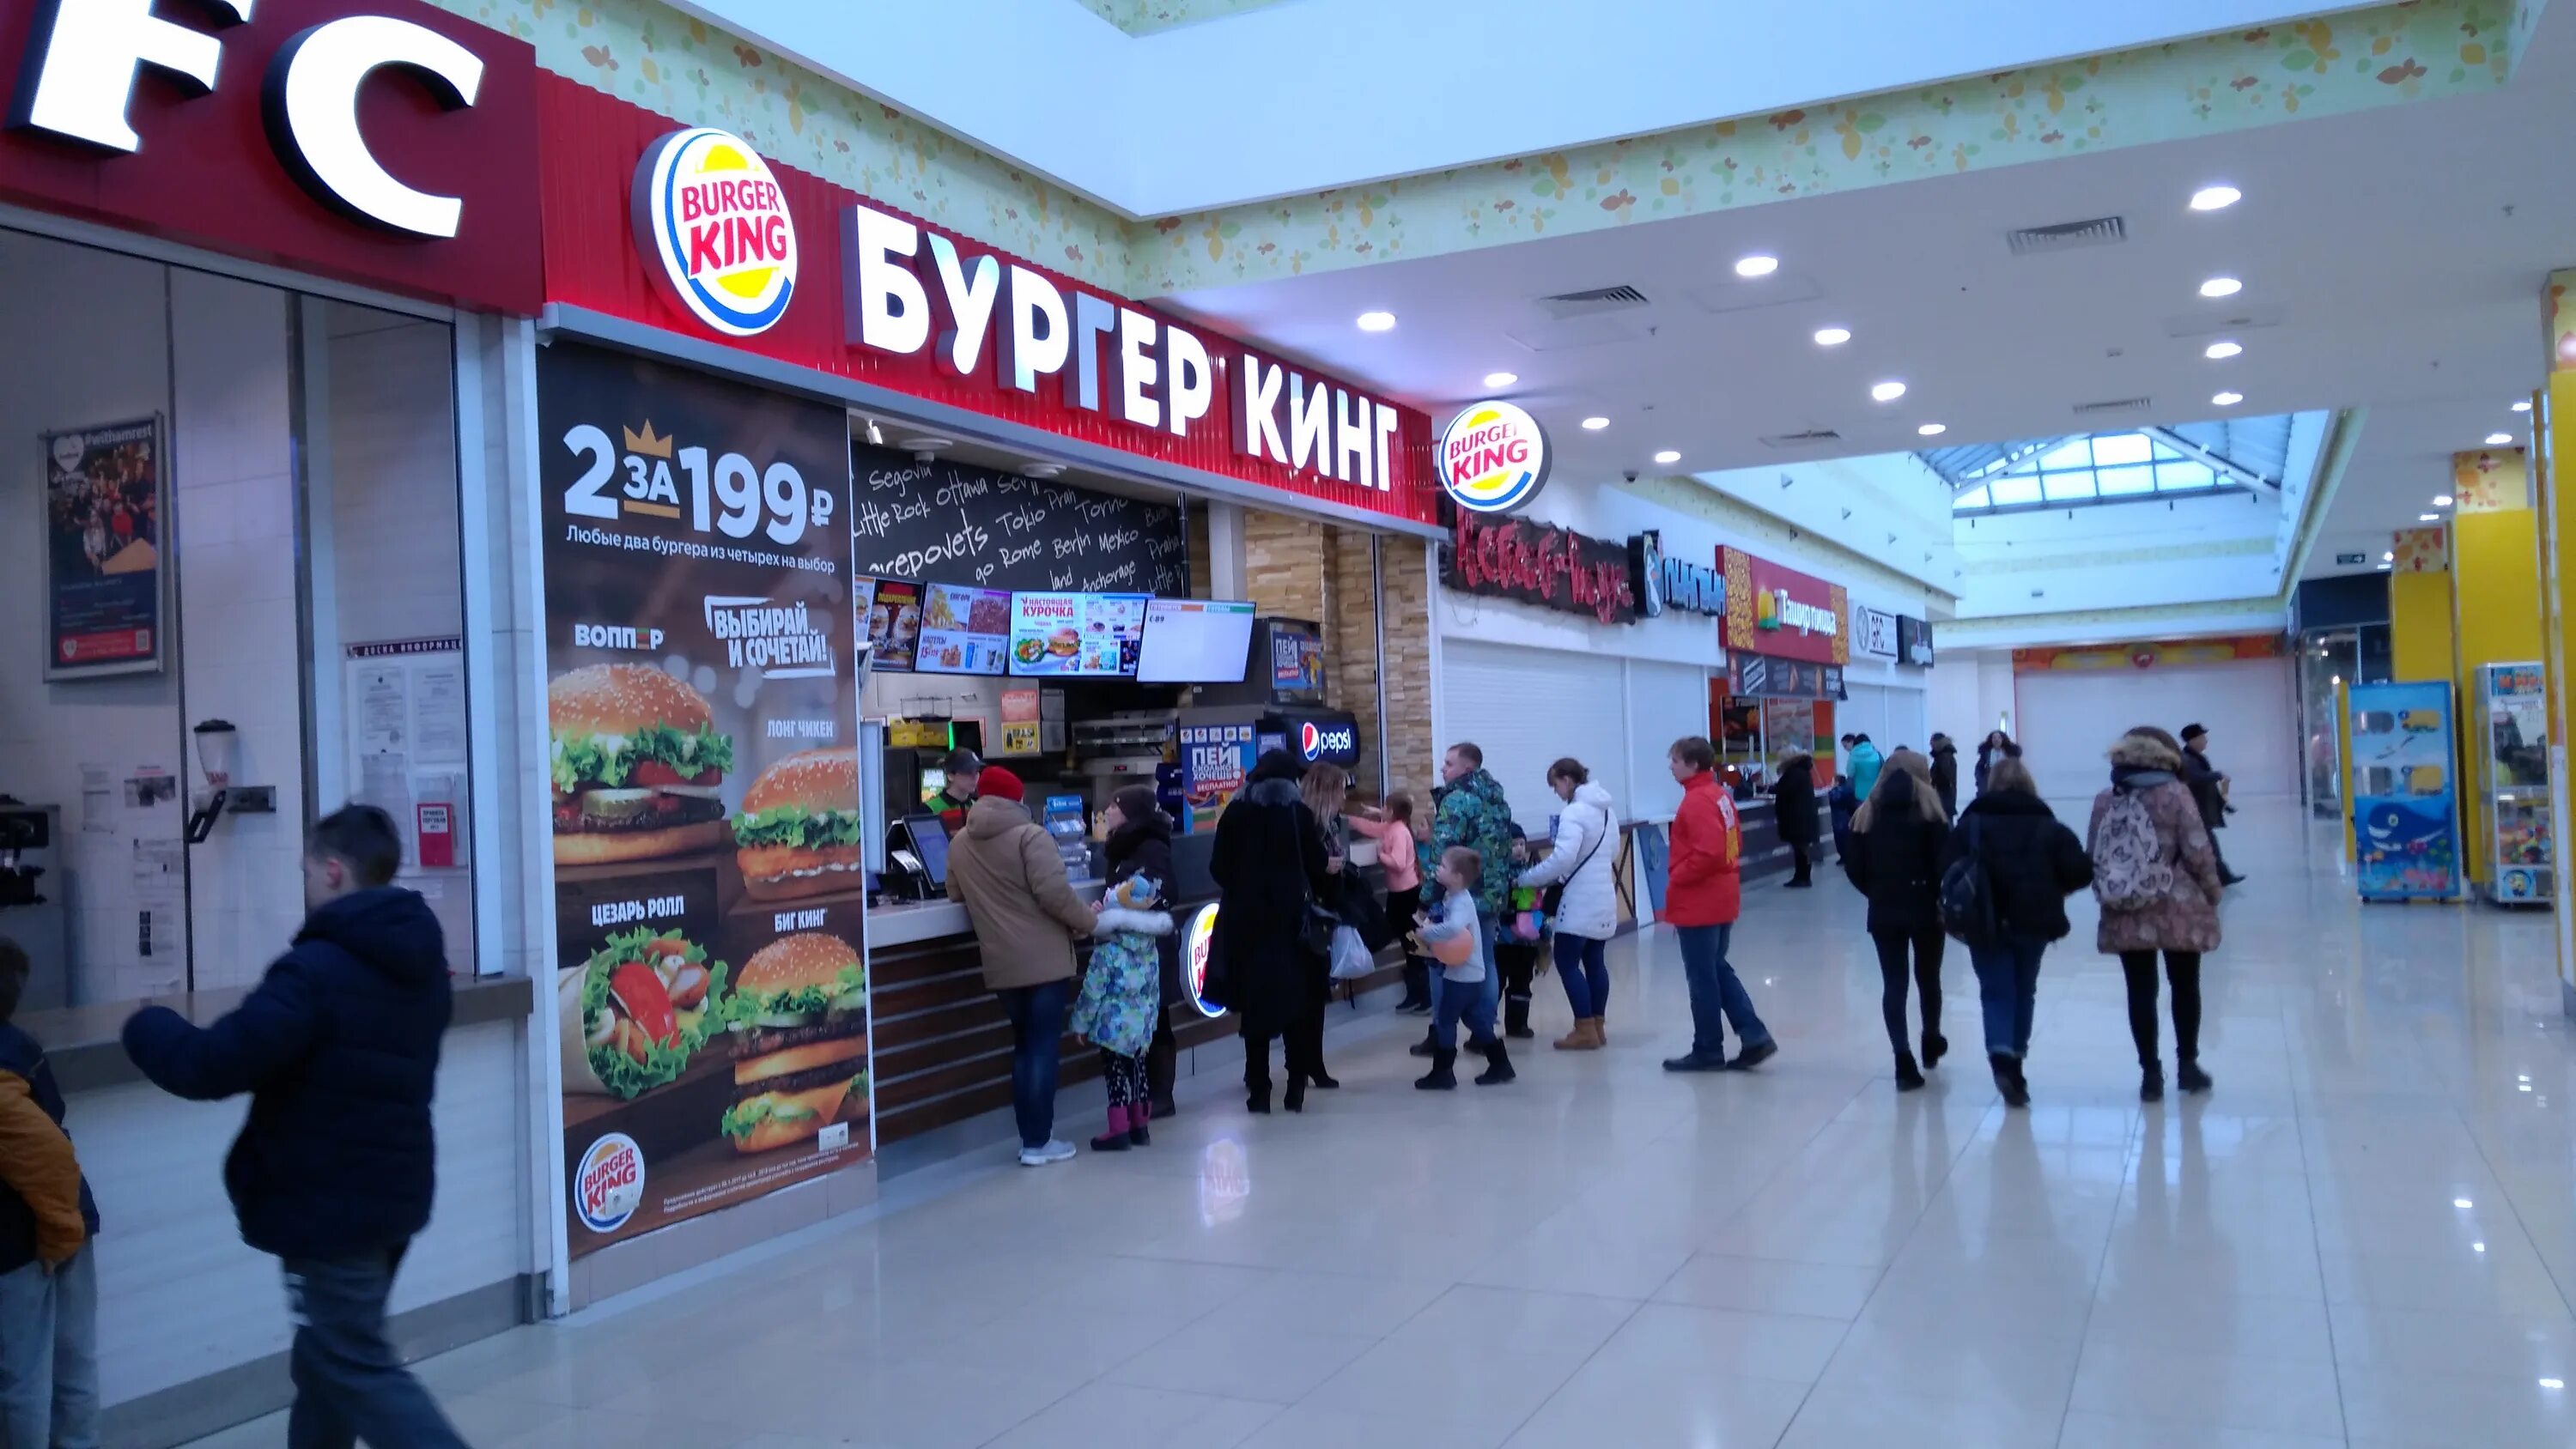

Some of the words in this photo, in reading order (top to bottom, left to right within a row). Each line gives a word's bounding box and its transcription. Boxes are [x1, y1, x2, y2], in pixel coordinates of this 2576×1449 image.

[681, 179, 781, 222] BURGER
[690, 215, 787, 276] KING
[855, 203, 1212, 437] БУРГЕР
[1242, 352, 1398, 493] КИНГ
[562, 424, 618, 520] 2
[623, 456, 679, 505] ЗА
[1453, 439, 1528, 487] KING
[890, 492, 931, 524] Rock
[936, 470, 988, 506] Ottawa
[995, 502, 1045, 537] Tokio
[566, 524, 621, 549] Любые
[623, 535, 649, 552] два
[653, 539, 708, 559] бургера
[710, 546, 725, 559] из
[726, 549, 780, 569] четырех
[781, 556, 796, 569] на
[798, 555, 835, 573] выбор
[999, 539, 1042, 568] Rome
[1052, 526, 1091, 559] Berlin
[1098, 524, 1139, 554] Mexico
[1082, 561, 1136, 592] Anchorage
[714, 601, 809, 640] ВЫБИРАЙ
[1023, 606, 1073, 617] КУРОЧКА
[728, 640, 743, 669] И
[745, 628, 829, 667] СОЧЕТАЙ!
[768, 720, 796, 737] ЛОНГ
[798, 720, 834, 738] ЧИКЕН
[1320, 728, 1352, 755] pepsi
[592, 900, 645, 927] ЦЕЗАРЬ
[647, 895, 684, 920] РОЛЛ
[775, 912, 796, 932] БИГ
[798, 909, 827, 929] КИНГ
[585, 1148, 634, 1193] BURGER
[587, 1162, 636, 1216] KING
